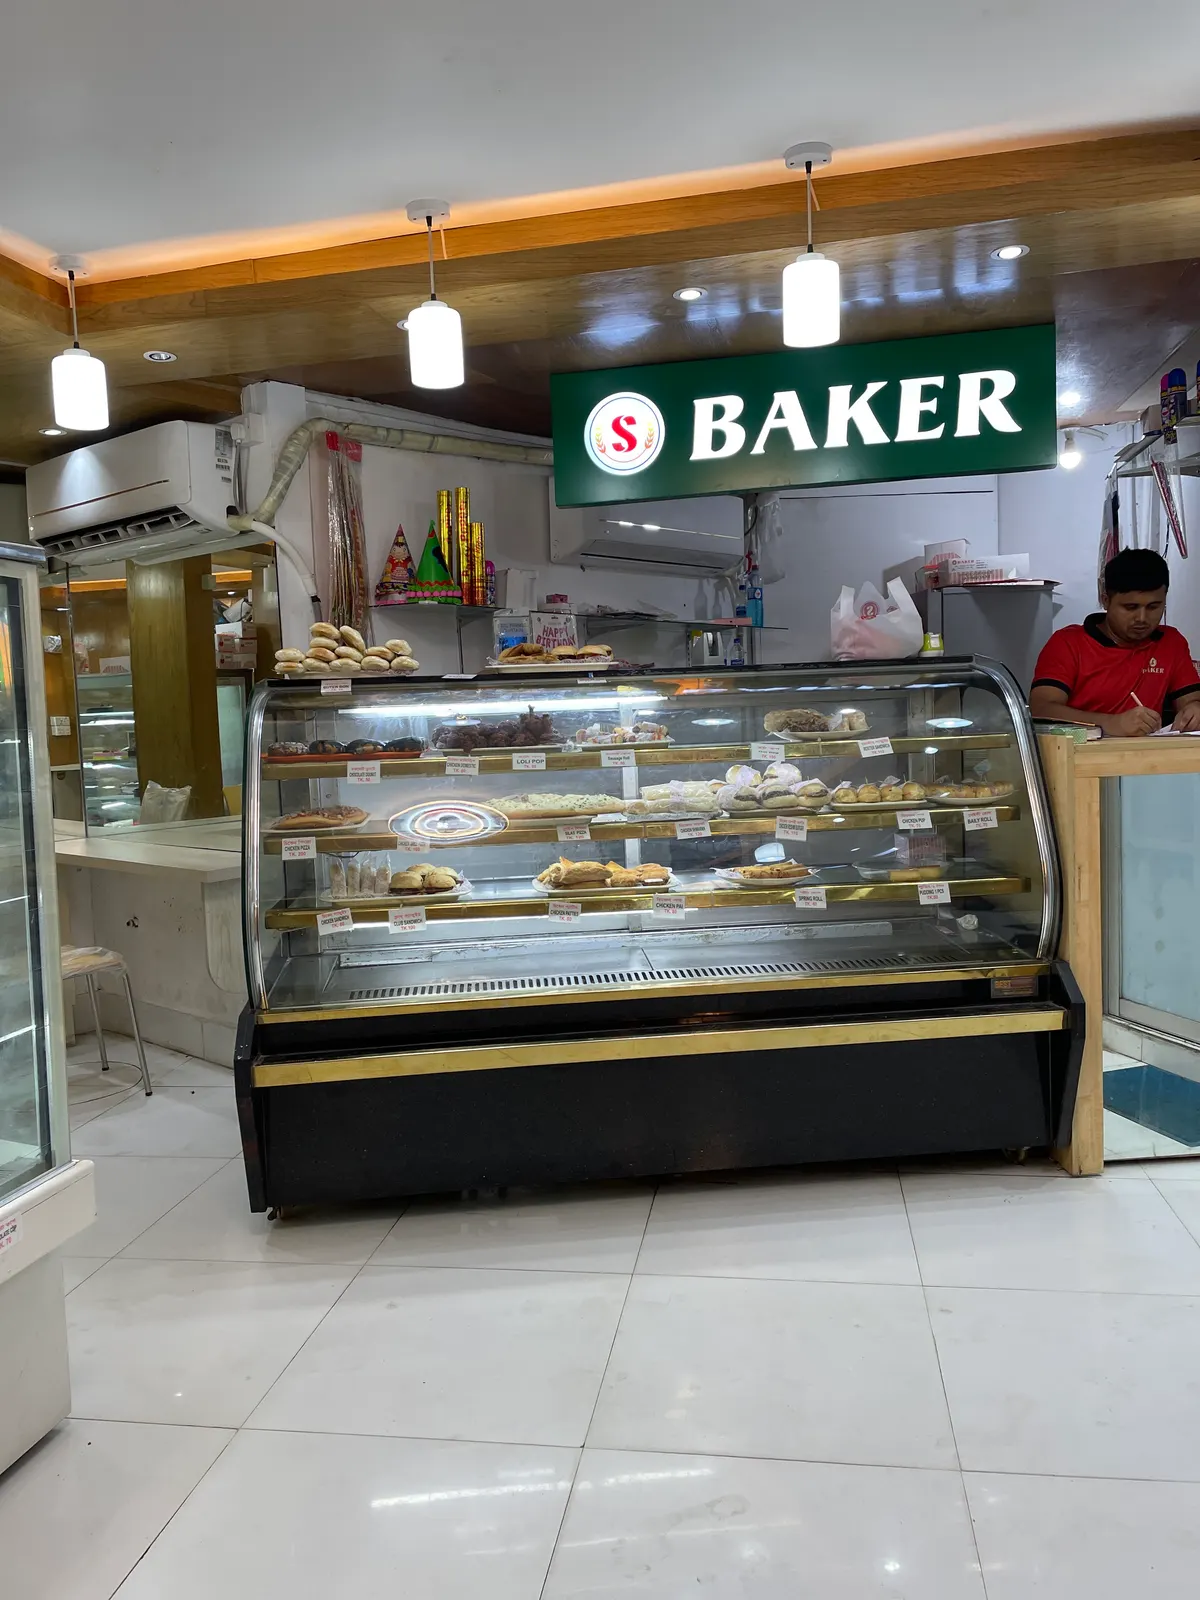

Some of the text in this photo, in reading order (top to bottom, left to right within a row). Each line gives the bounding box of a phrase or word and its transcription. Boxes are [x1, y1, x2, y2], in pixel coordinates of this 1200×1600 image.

[689, 370, 1023, 461] BAKER
[611, 415, 637, 453] S
[542, 625, 569, 639] HAPPY
[535, 634, 576, 649] BIRTHDAY
[404, 918, 423, 926] SANDWICH
